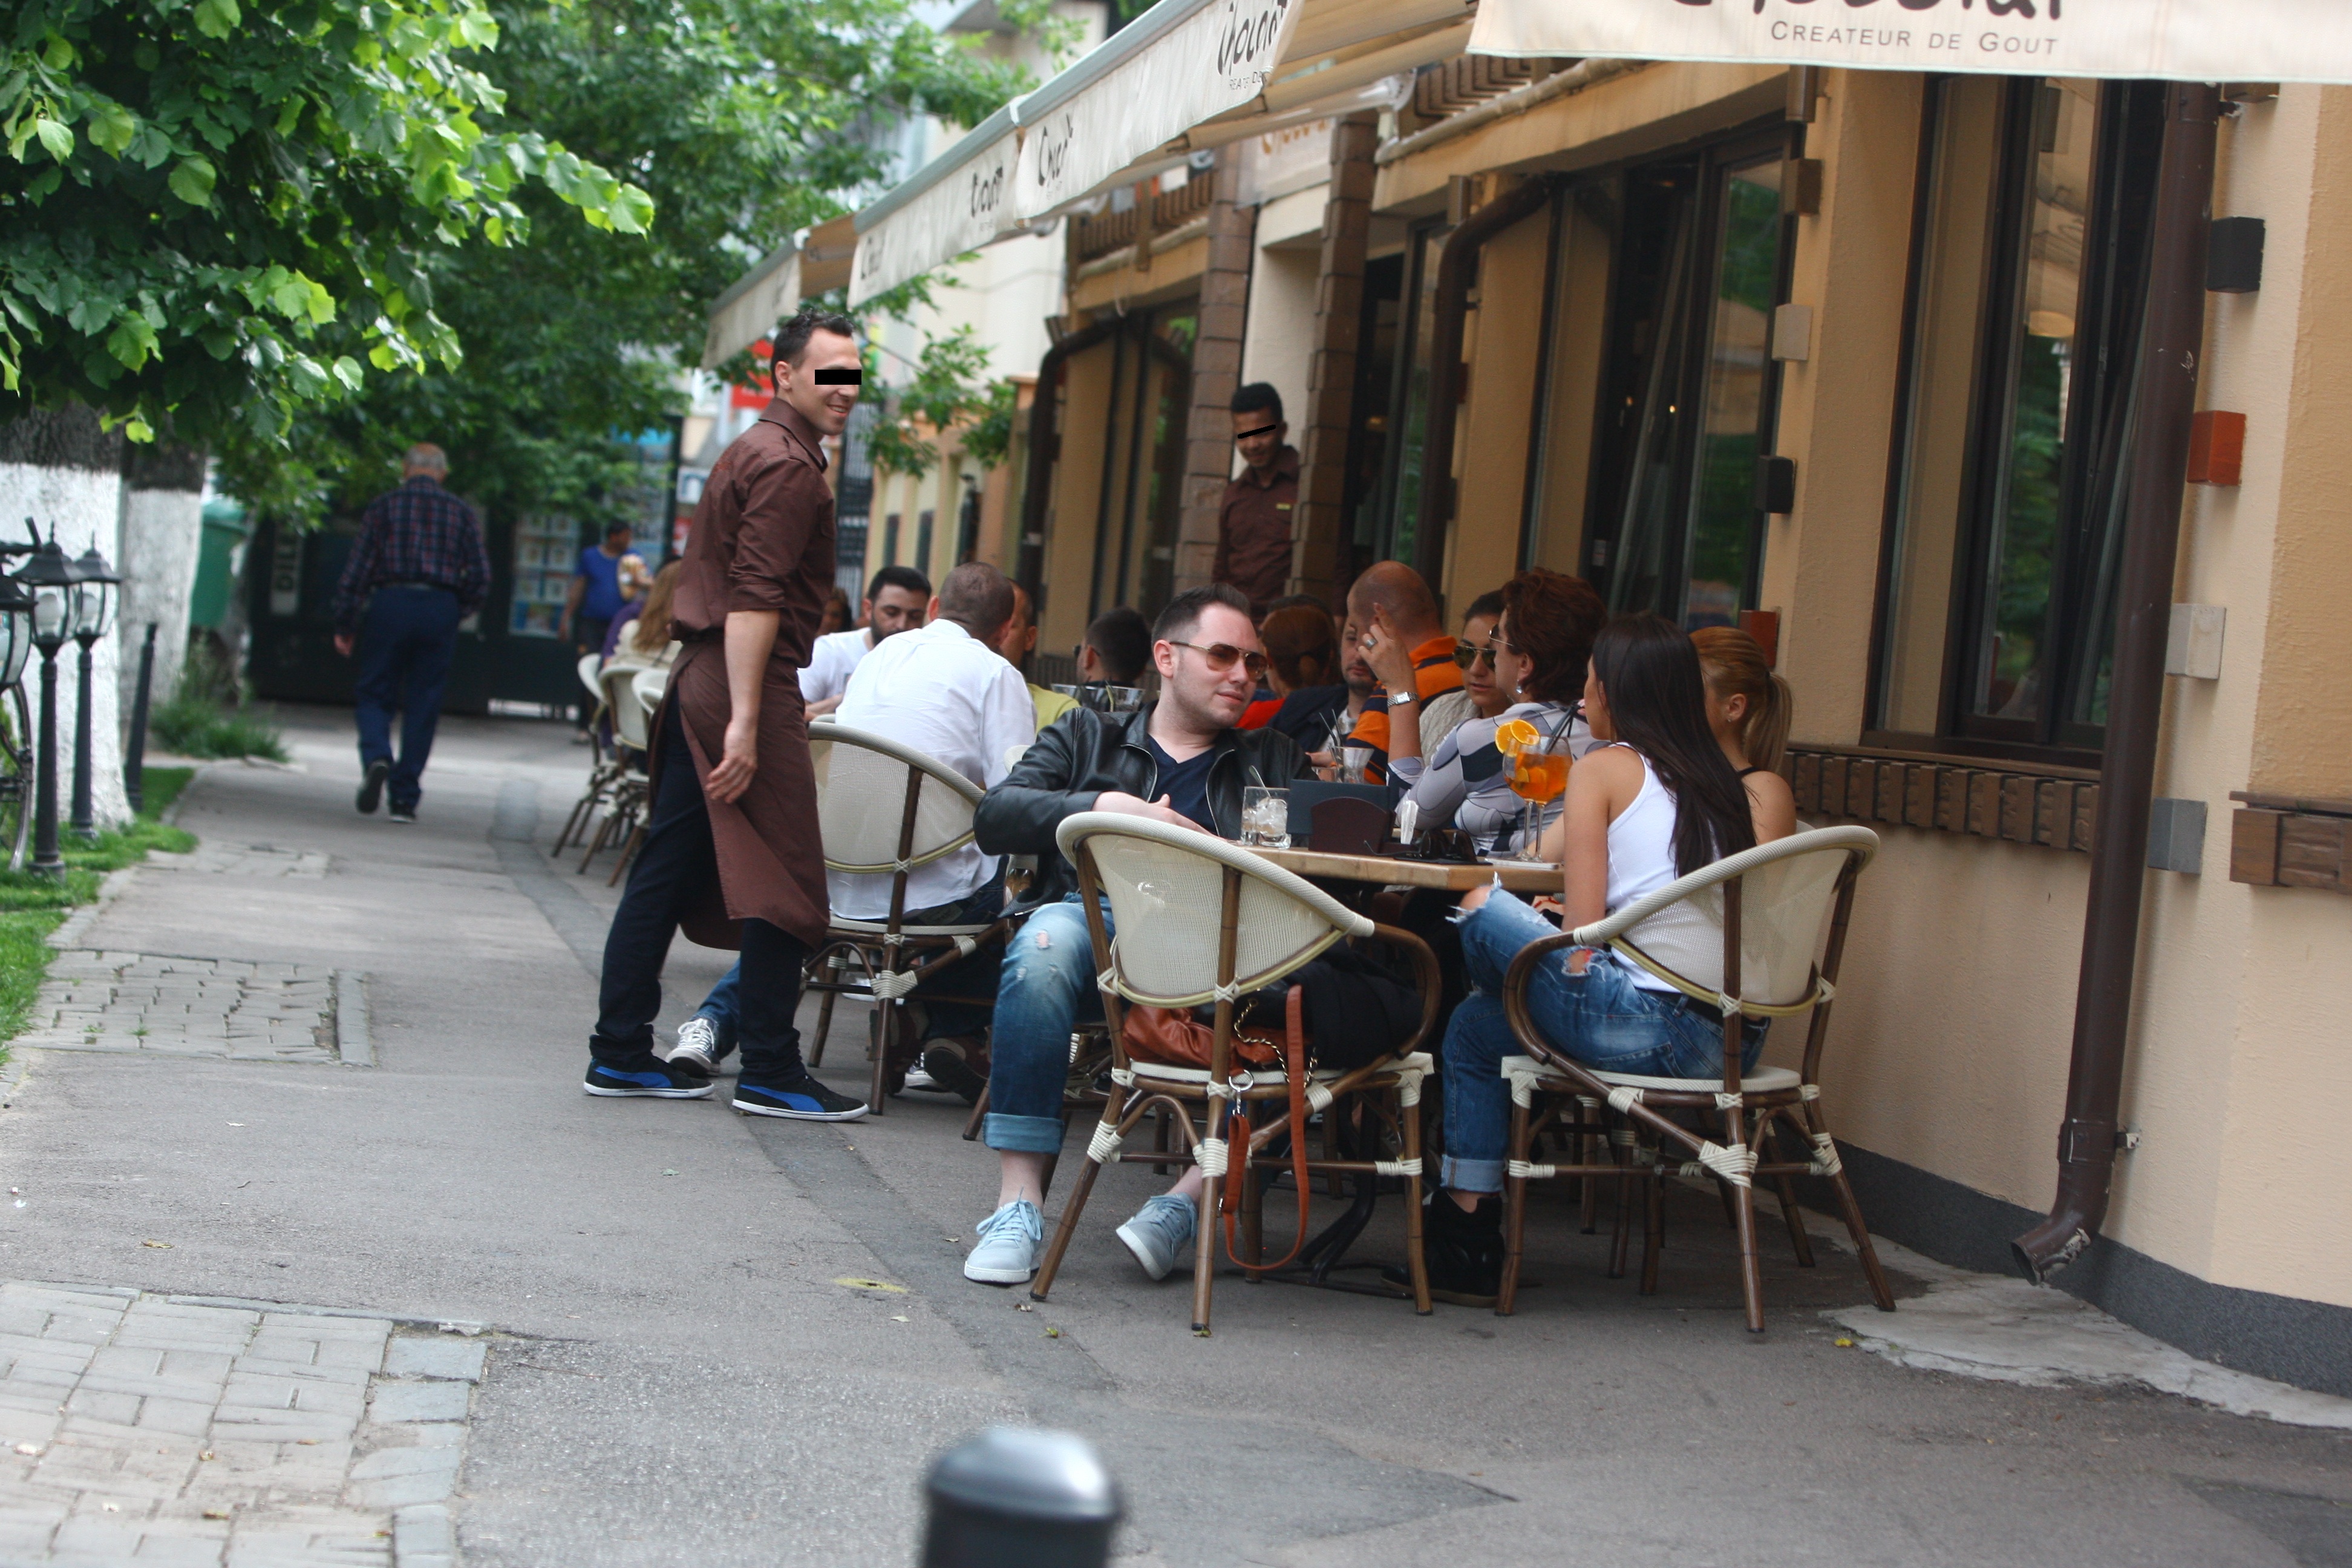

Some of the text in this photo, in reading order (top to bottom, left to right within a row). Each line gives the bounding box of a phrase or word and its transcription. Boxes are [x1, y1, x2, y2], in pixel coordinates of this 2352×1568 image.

[1771, 20, 2059, 55] CREATEUR DE GOUT
